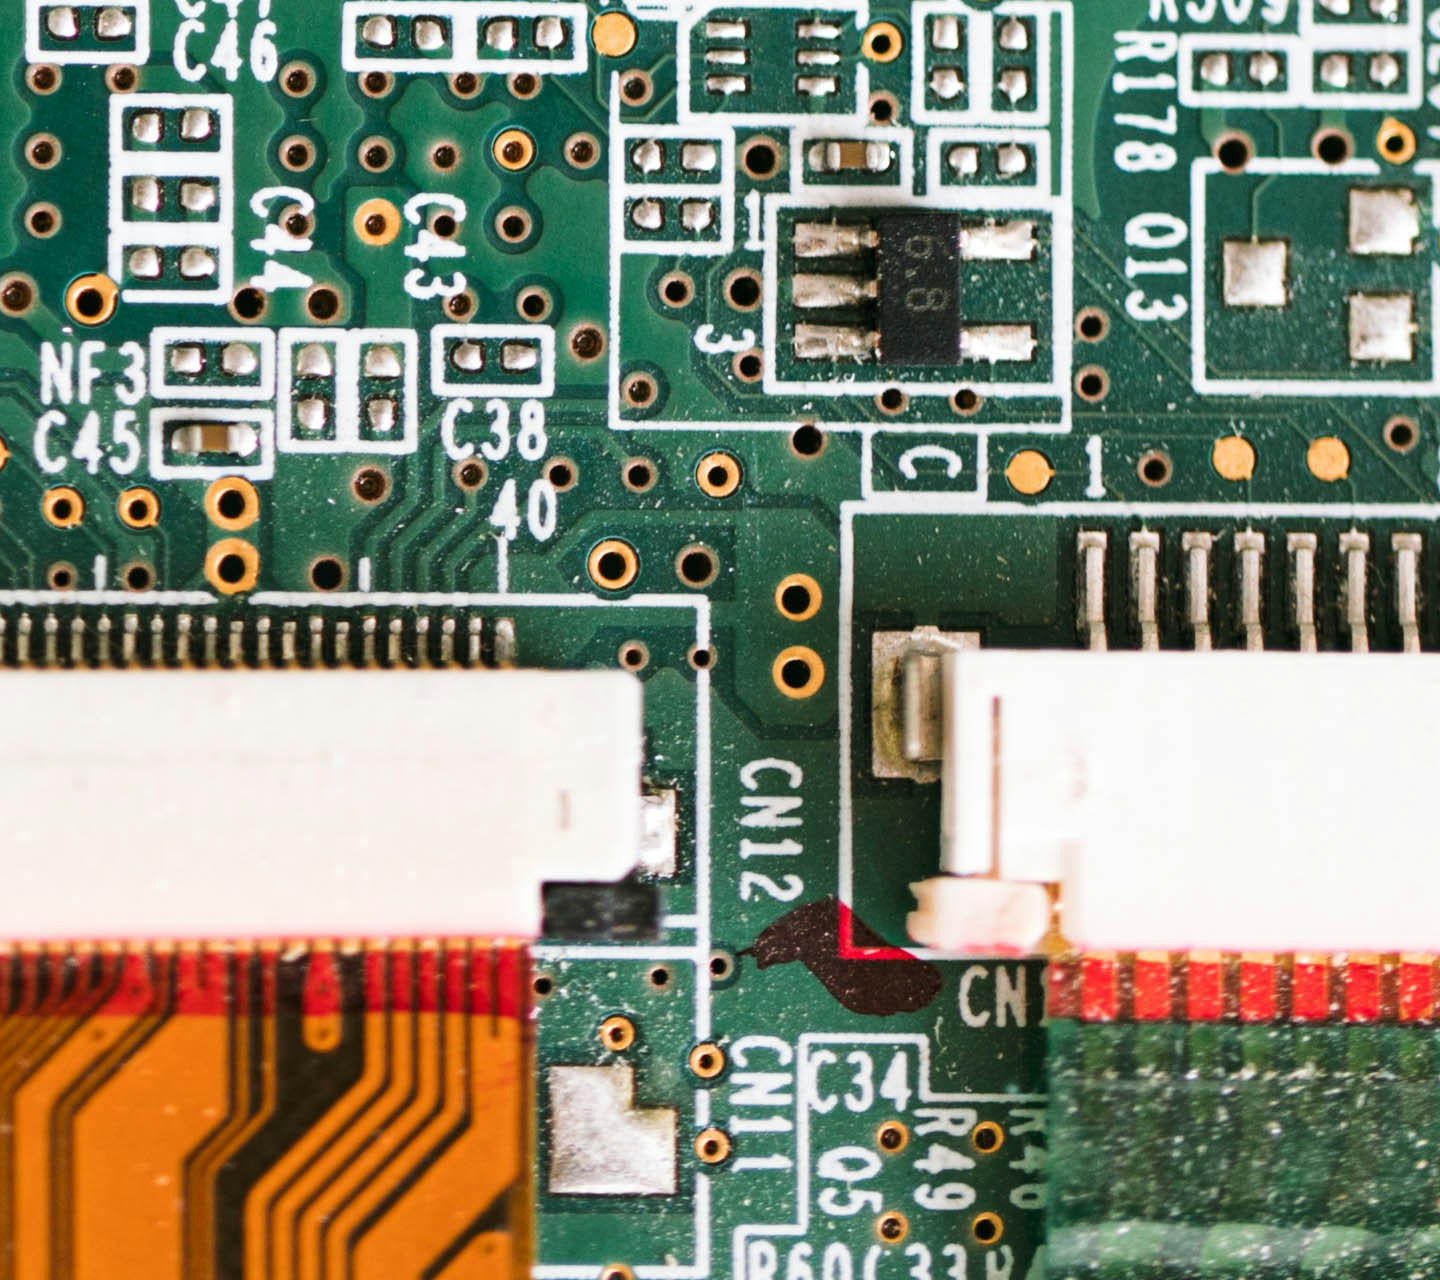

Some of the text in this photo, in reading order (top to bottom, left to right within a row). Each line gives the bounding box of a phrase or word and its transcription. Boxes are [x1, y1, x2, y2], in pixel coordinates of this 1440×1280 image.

[174, 20, 277, 81] C46
[1114, 31, 1178, 173] R178
[40, 341, 148, 404] NF3
[33, 411, 143, 474] C45
[443, 398, 546, 460] C38
[492, 479, 558, 539] 40
[739, 758, 804, 903] CN12
[729, 1037, 793, 1172] CN11
[808, 1051, 911, 1112] C34
[913, 1110, 976, 1210] R49
